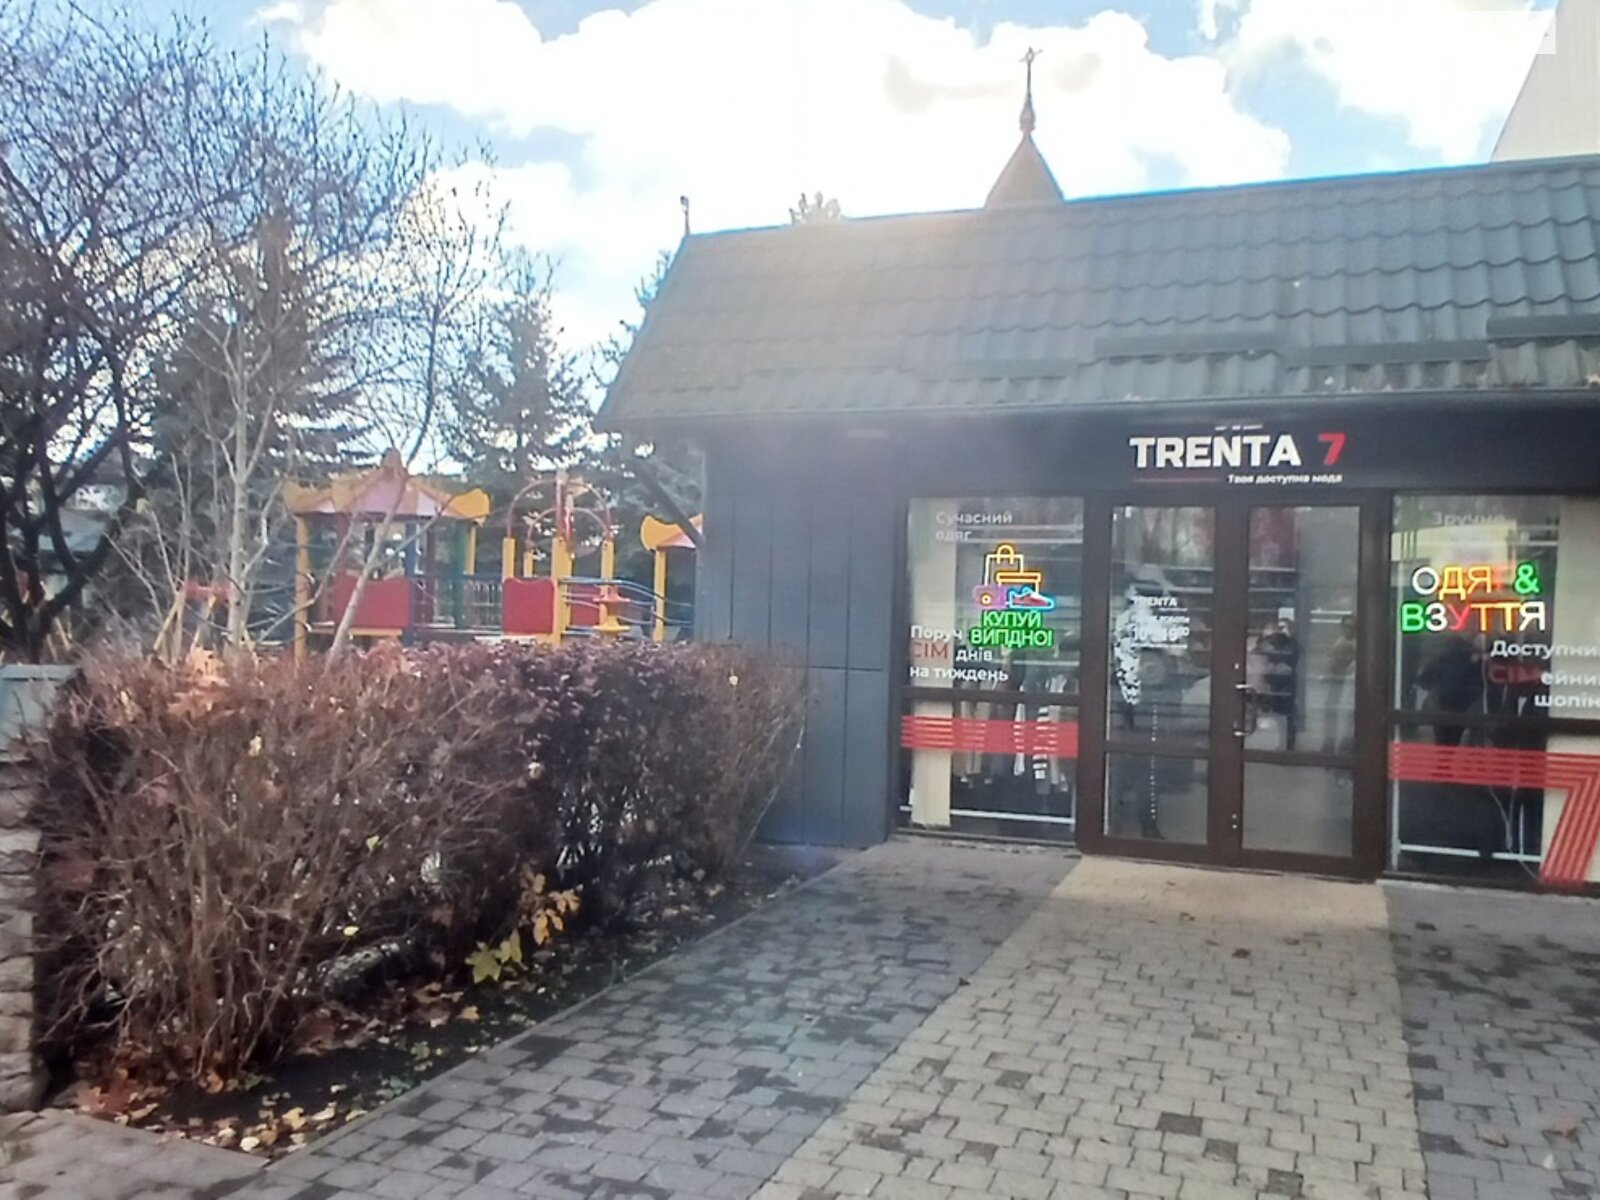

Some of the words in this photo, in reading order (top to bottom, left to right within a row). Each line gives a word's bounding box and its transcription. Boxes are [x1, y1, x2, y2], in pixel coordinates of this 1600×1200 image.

[1128, 434, 1302, 468] TRENTA
[1317, 431, 1347, 467] 7
[1312, 474, 1343, 484] мода
[935, 510, 1013, 527] Сучасний
[935, 530, 972, 542] одяг
[1514, 563, 1541, 595] &
[983, 609, 1042, 628] КУПУЙ
[1401, 601, 1546, 632] ВЗУТТЯ
[910, 625, 963, 642] Поруч
[911, 641, 948, 659] СІМ
[956, 646, 993, 662] днів
[1490, 639, 1600, 660] Доступни
[909, 665, 930, 678] на
[933, 667, 1009, 682] тиждень
